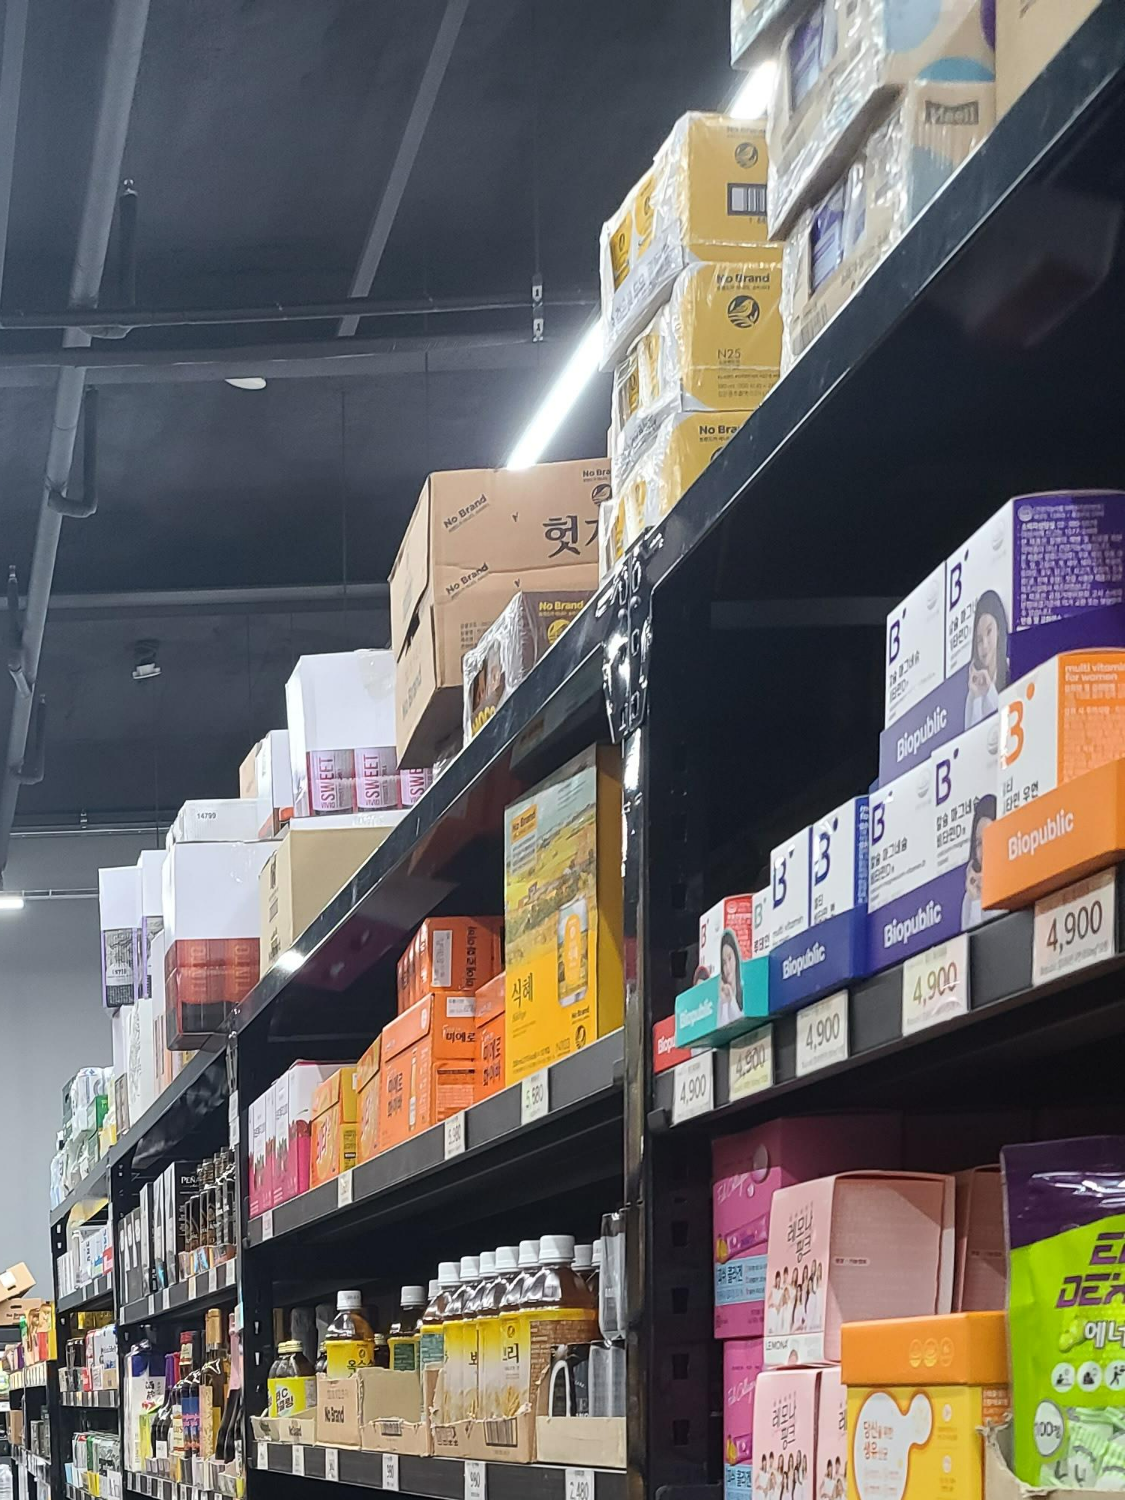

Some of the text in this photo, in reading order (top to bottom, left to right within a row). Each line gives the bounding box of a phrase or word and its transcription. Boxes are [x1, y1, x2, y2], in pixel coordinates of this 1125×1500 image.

[716, 272, 771, 285] No Brand
[717, 348, 742, 360] N25
[699, 424, 716, 435] No
[582, 468, 595, 478] No
[443, 494, 488, 529] No Brand
[445, 562, 489, 596] No Brand
[538, 599, 585, 611] No Brand
[1078, 673, 1118, 682] women
[895, 705, 949, 764] Biopublic
[319, 756, 336, 802] SWEET
[363, 753, 381, 799] SWEET
[196, 811, 218, 820] 14799
[1007, 808, 1075, 862] Biopublic
[883, 899, 943, 949] Biopublic
[1045, 898, 1105, 956] 4,900
[782, 942, 827, 981] Biopublic
[511, 971, 534, 1010] 식혜
[912, 960, 960, 1008] 4,900
[679, 993, 714, 1030] Biopublic
[805, 1012, 841, 1051] 4,900
[679, 1074, 708, 1106] 4,900
[786, 1208, 814, 1244] 레모나
[765, 1340, 788, 1352] LEMONA
[772, 1402, 797, 1430] 레모나
[568, 1480, 590, 1500] 2,480
